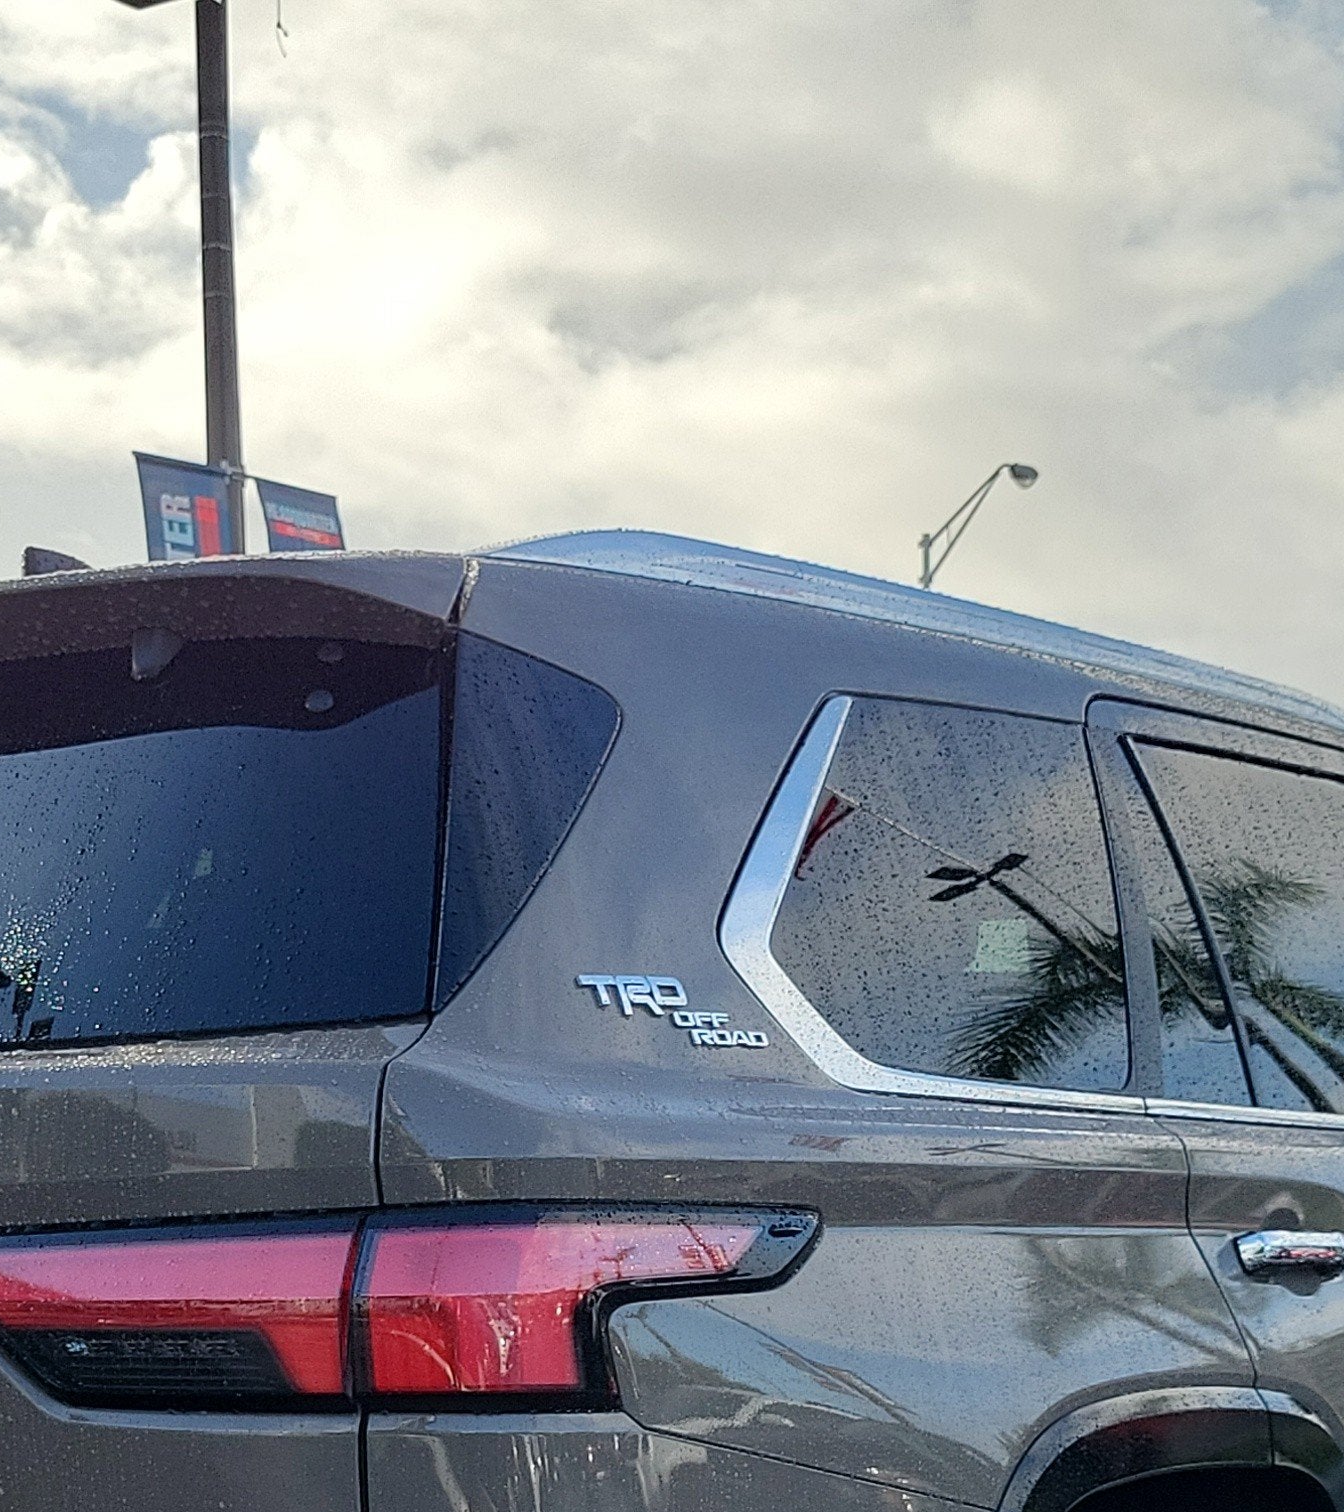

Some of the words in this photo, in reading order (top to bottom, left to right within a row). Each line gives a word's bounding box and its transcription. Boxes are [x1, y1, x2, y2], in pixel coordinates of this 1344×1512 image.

[576, 974, 688, 1017] TRD
[671, 1010, 730, 1028] OFF
[690, 1028, 770, 1047] ROAD
